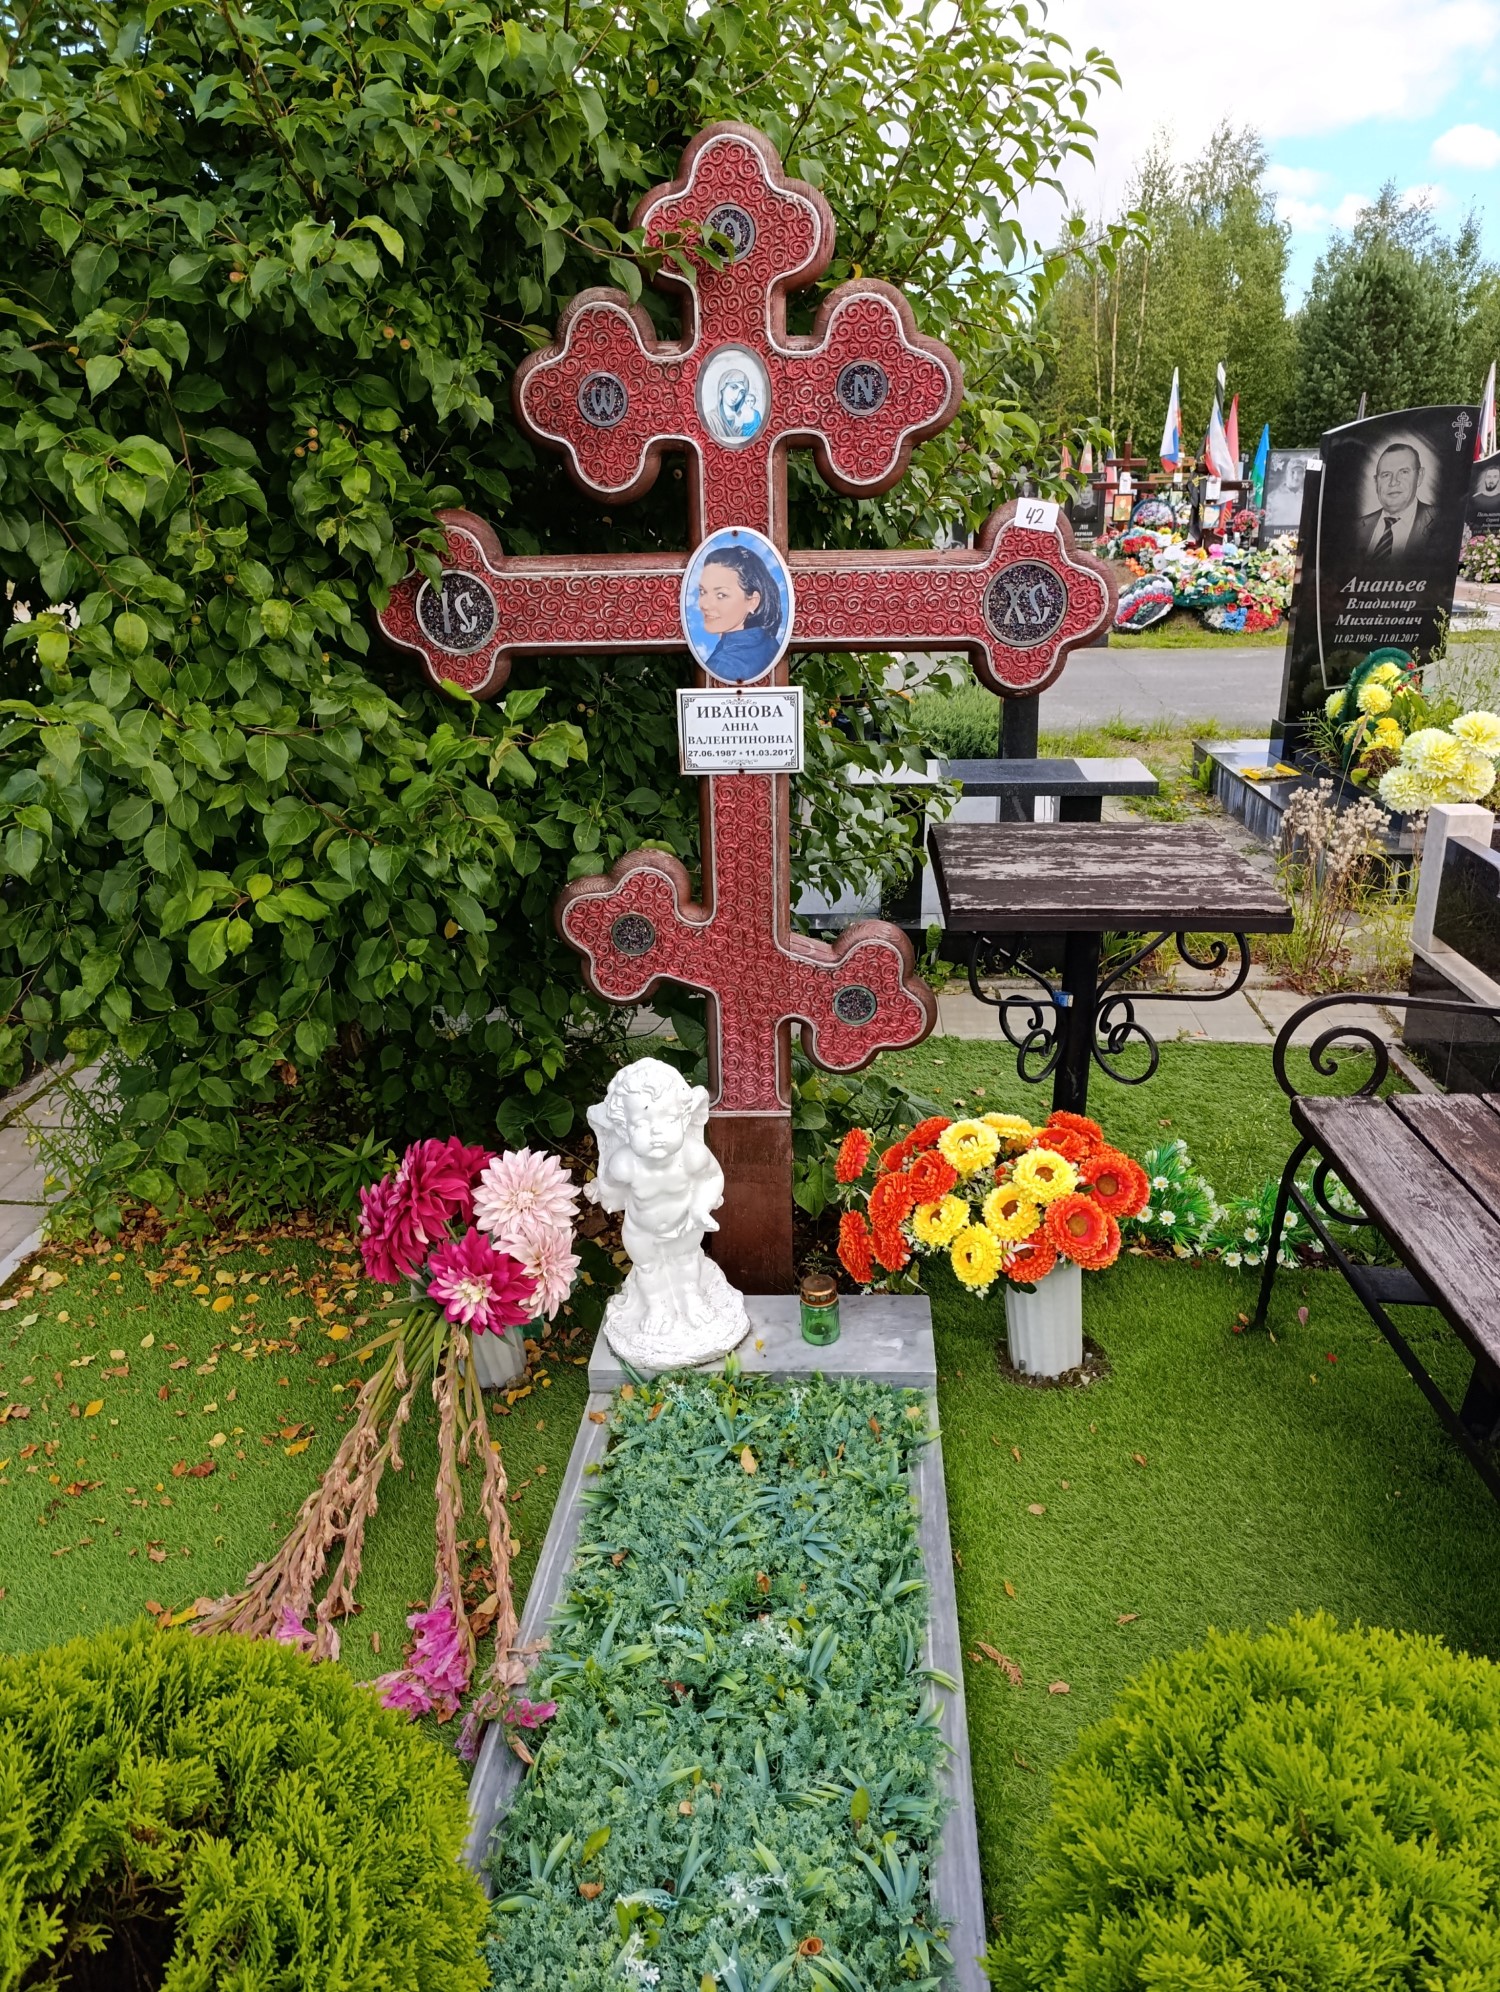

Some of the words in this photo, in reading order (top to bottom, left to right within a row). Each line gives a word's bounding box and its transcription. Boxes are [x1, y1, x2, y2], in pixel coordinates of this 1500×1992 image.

[1025, 507, 1045, 525] 42
[1340, 576, 1427, 593] Ананьев
[1346, 597, 1417, 612] Владимир
[1335, 614, 1422, 626] Михайлович
[1334, 634, 1373, 643] 11.02.1950
[1379, 633, 1419, 643] 11.01.2017
[696, 705, 784, 719] ИВАНОВА
[721, 722, 759, 732] АННА
[688, 735, 793, 745] ВАЛЕНТИНОВНА
[745, 749, 794, 757] 11.03.2017
